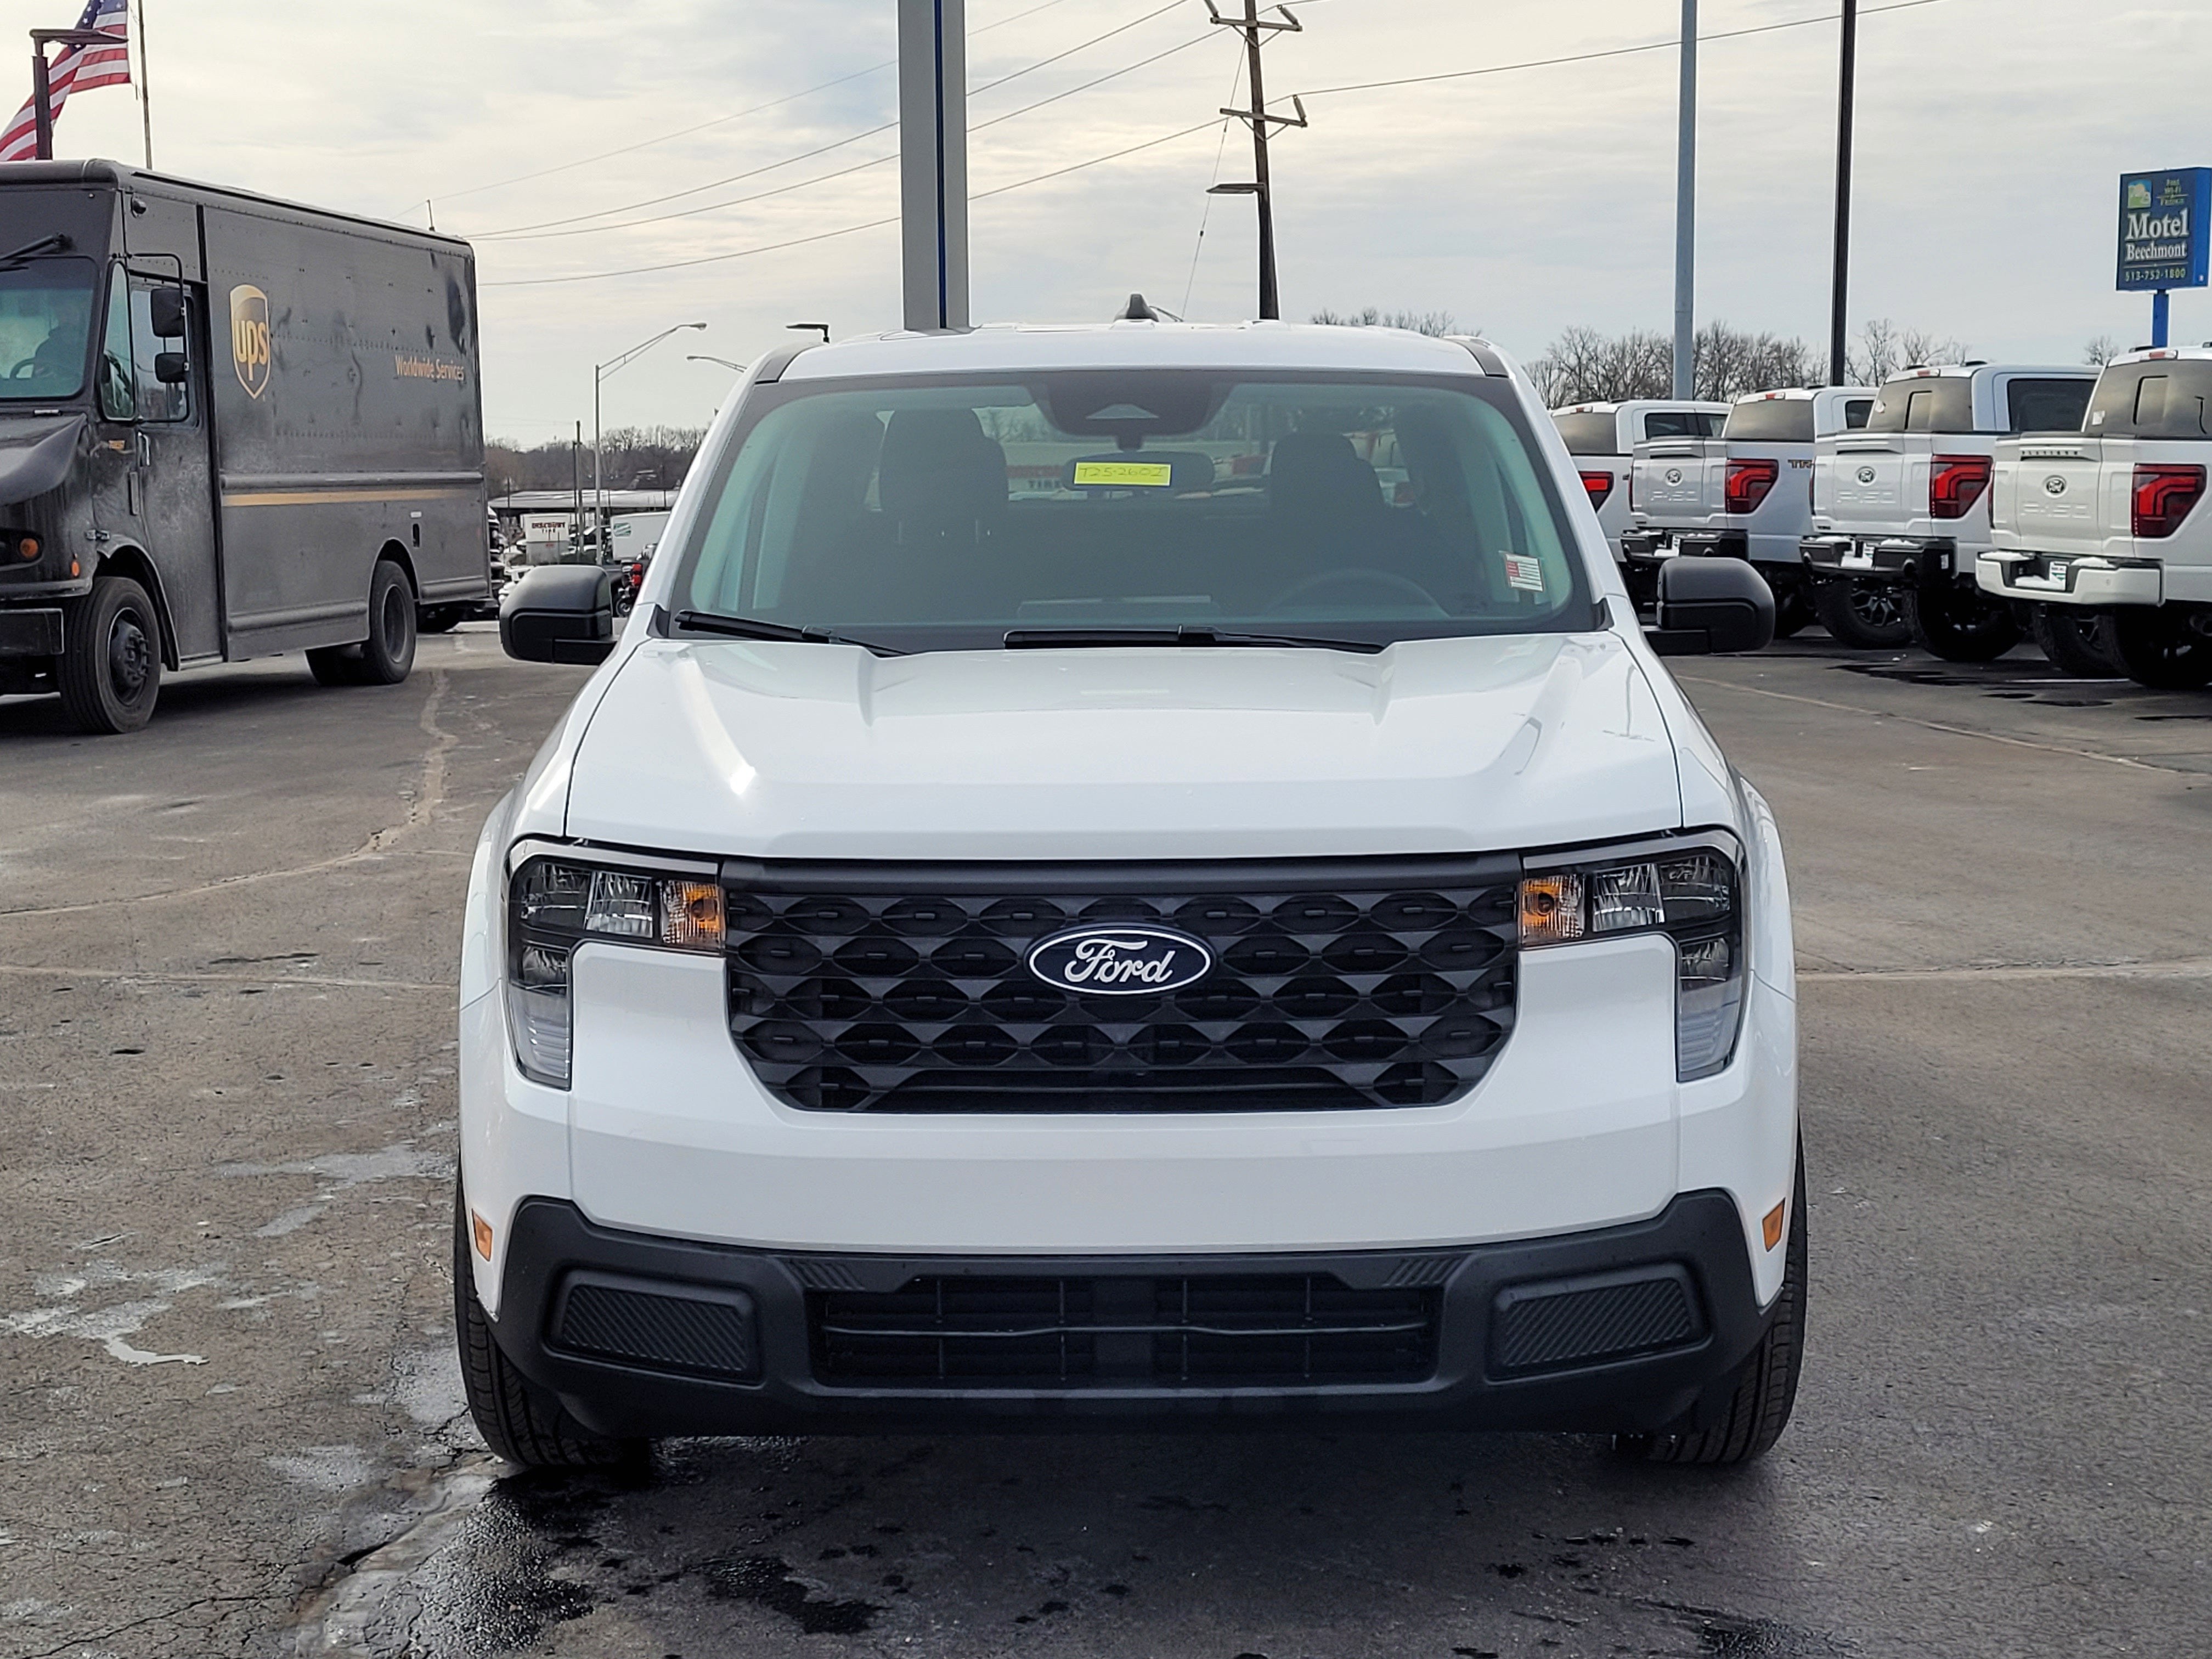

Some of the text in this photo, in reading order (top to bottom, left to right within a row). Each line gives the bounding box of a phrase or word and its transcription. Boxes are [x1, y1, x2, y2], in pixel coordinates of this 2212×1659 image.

[2125, 208, 2190, 241] Motel
[2125, 241, 2187, 262] Beechmont
[235, 320, 268, 381] ups
[395, 354, 464, 381] Worldwide Services
[1788, 459, 1812, 469] TR
[1065, 939, 1176, 983] Ford
